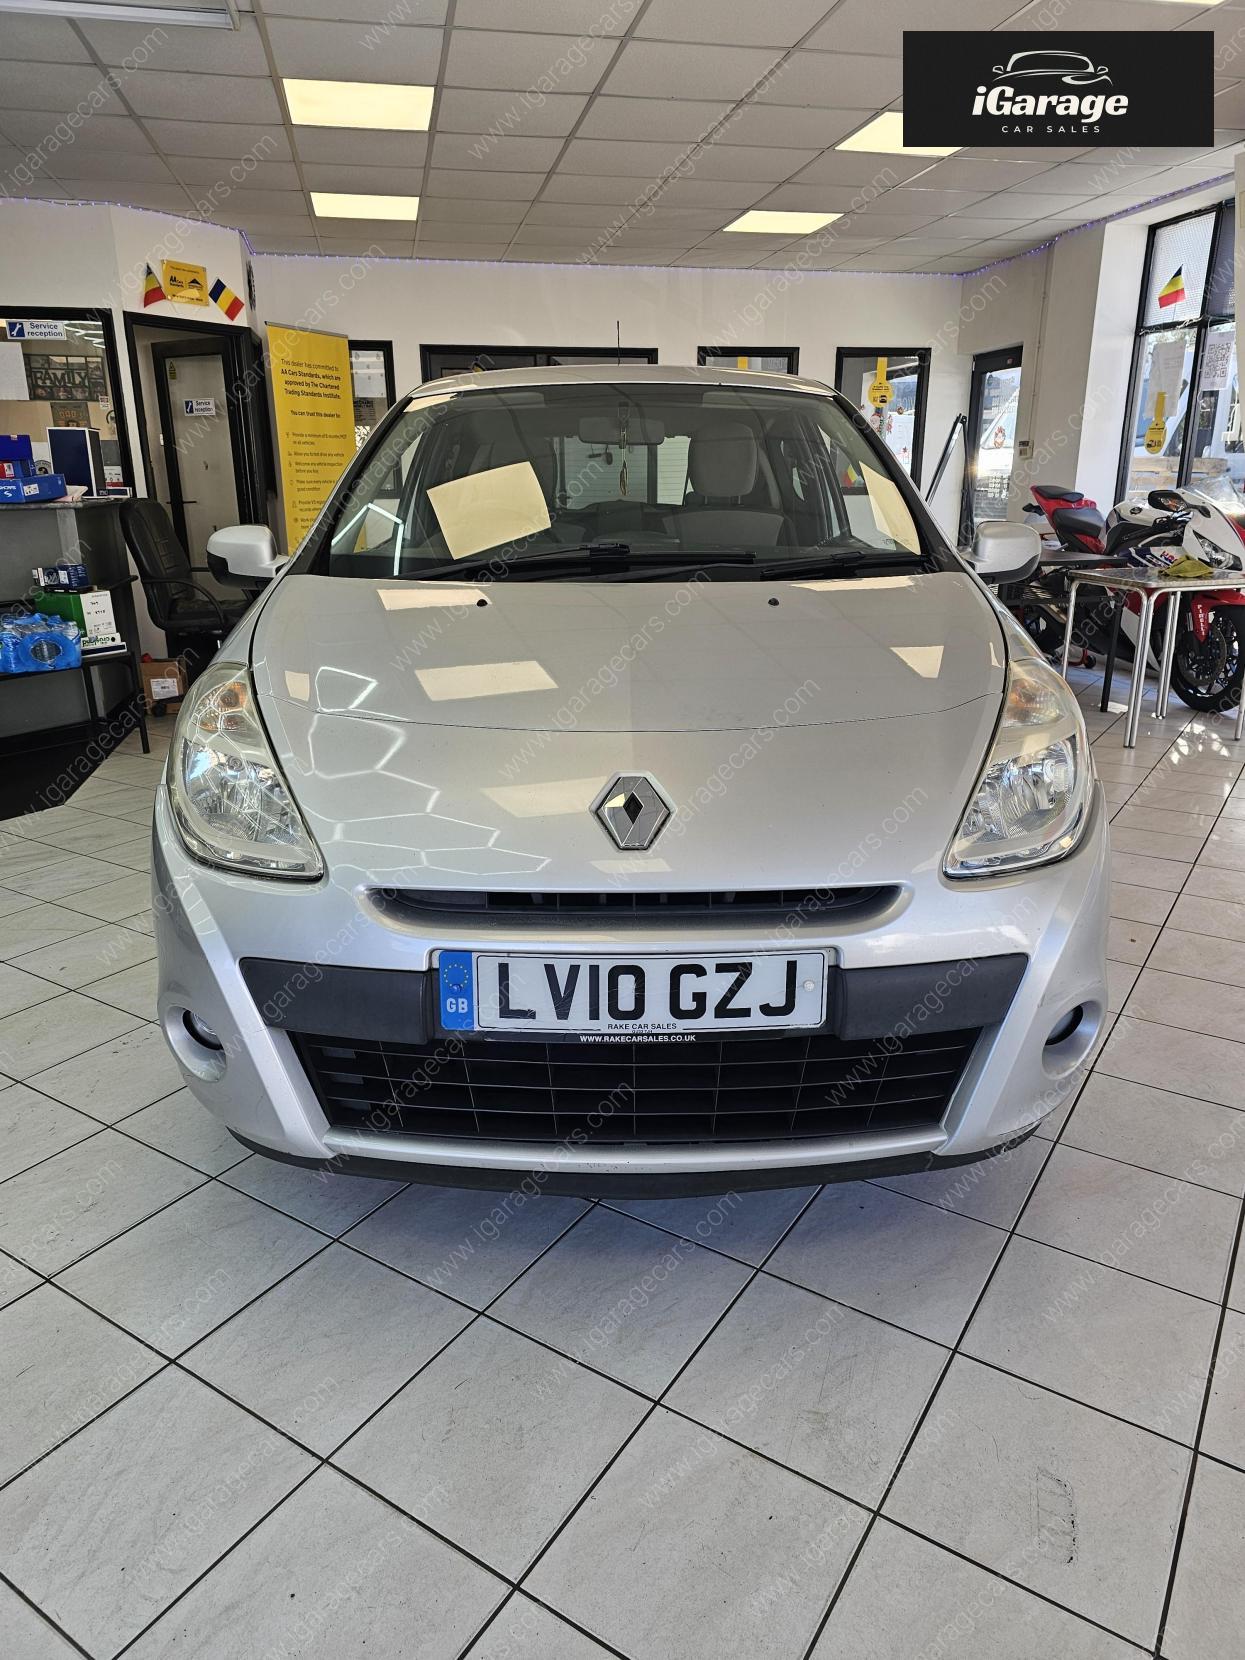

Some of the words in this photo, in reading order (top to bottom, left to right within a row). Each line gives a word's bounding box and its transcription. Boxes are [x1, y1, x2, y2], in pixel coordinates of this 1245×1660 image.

[30, 322, 58, 330] Service
[27, 330, 63, 338] reception
[32, 370, 88, 386] FAMILY
[298, 370, 321, 379] Standards,
[498, 962, 646, 1020] LV10
[669, 960, 798, 1020] GZJ
[446, 998, 468, 1014] GB
[580, 1034, 696, 1042] WWW.RAKECARSALES.CO.UK
